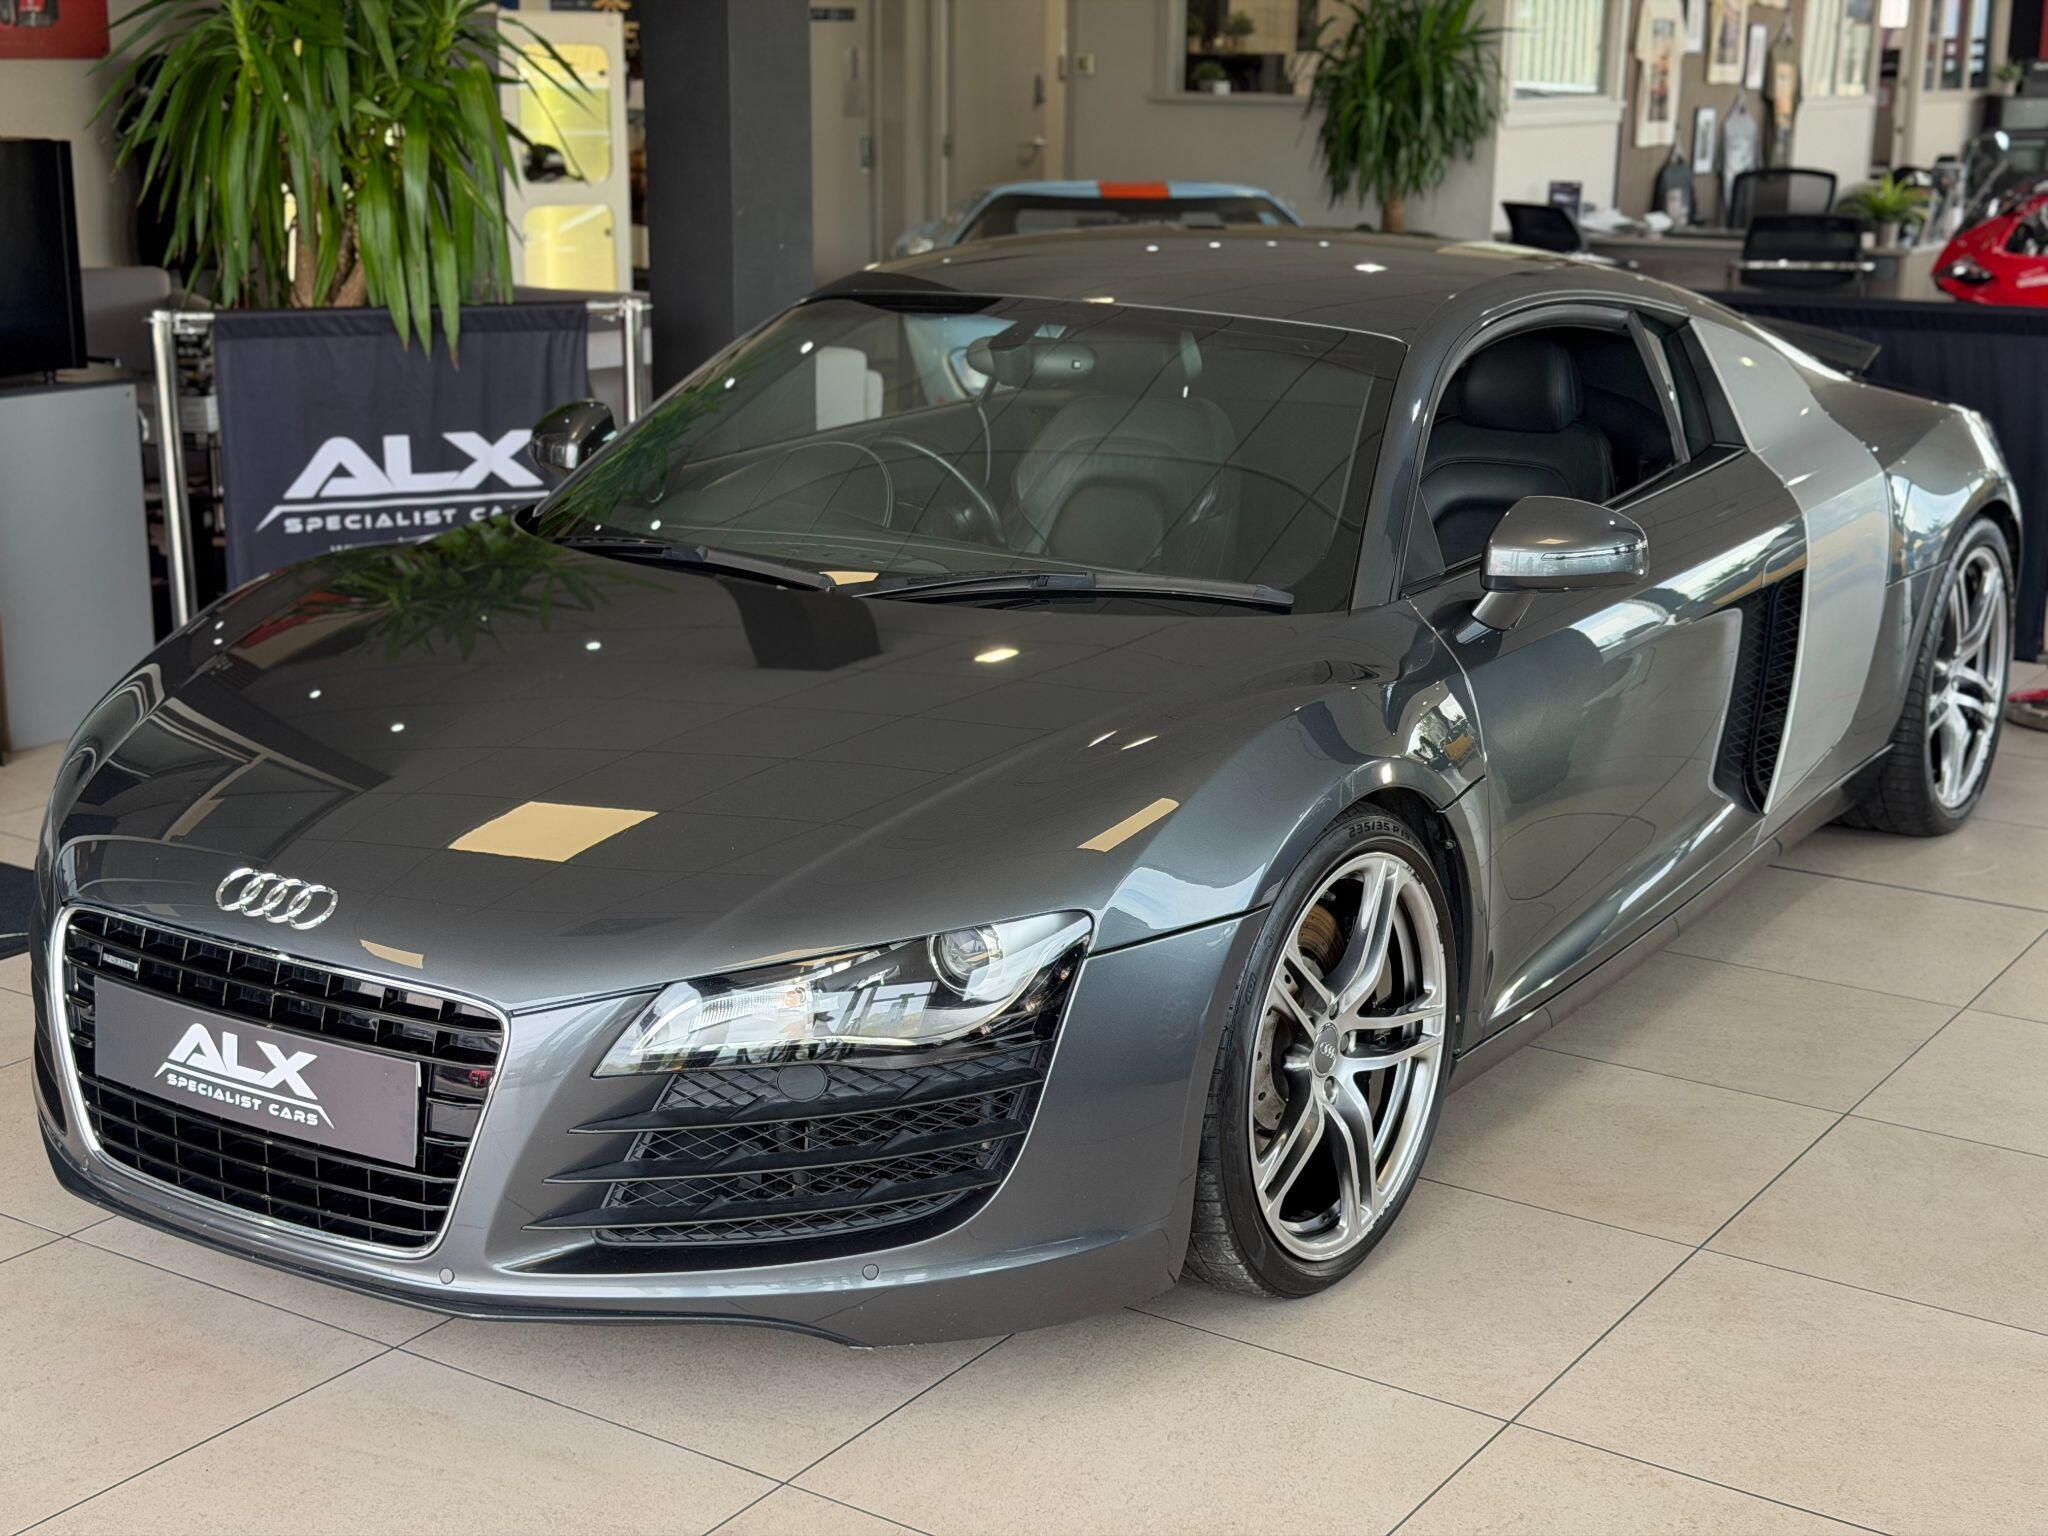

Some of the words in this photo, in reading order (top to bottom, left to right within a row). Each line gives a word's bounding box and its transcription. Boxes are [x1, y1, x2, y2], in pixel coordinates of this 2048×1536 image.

[283, 429, 544, 500] ALX
[284, 508, 457, 534] SPECIALIST
[469, 504, 517, 522] CA
[1348, 820, 1390, 839] 235/35
[167, 1022, 318, 1100] ALX
[166, 1074, 262, 1111] SPECIALIST
[268, 1103, 318, 1127] CARS
